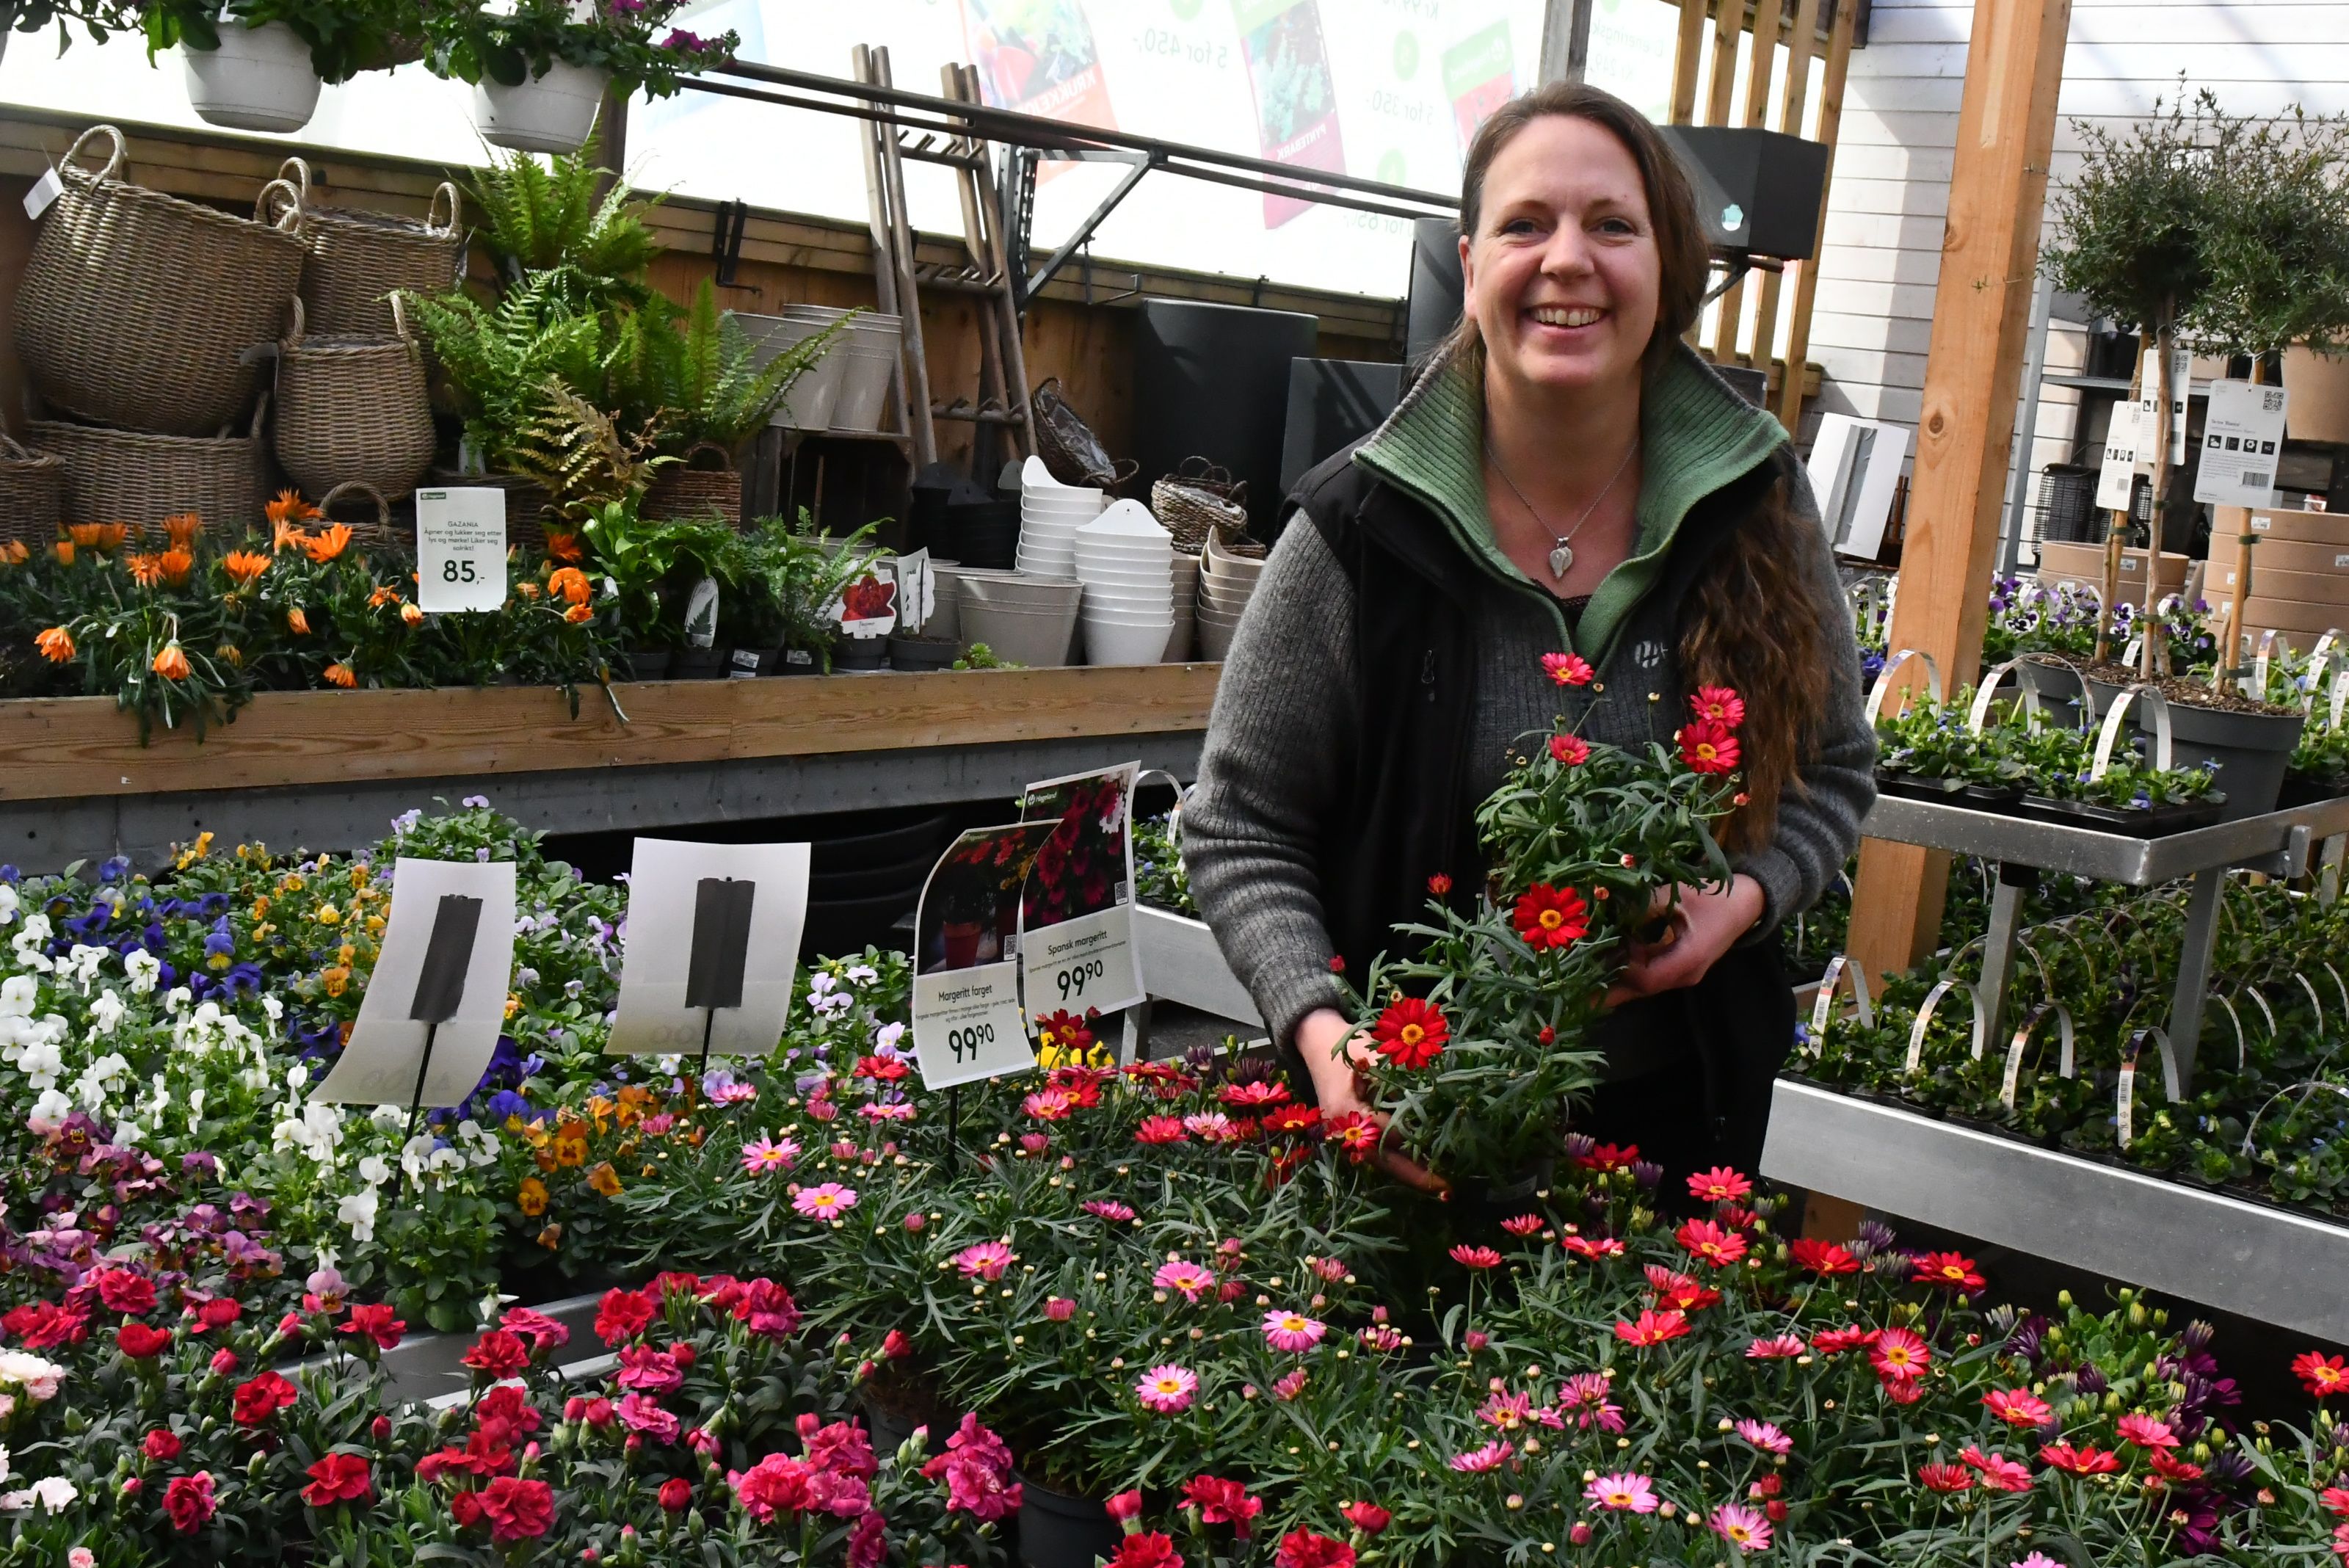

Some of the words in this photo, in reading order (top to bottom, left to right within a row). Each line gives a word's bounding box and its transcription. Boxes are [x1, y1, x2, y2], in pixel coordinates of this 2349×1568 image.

[424, 527, 443, 537] Åpner
[1036, 791, 1057, 803] Hageland
[1048, 939, 1074, 957] Spansk
[1075, 930, 1108, 946] margeritt
[938, 986, 970, 1003] Margeritt
[971, 984, 993, 998] farget
